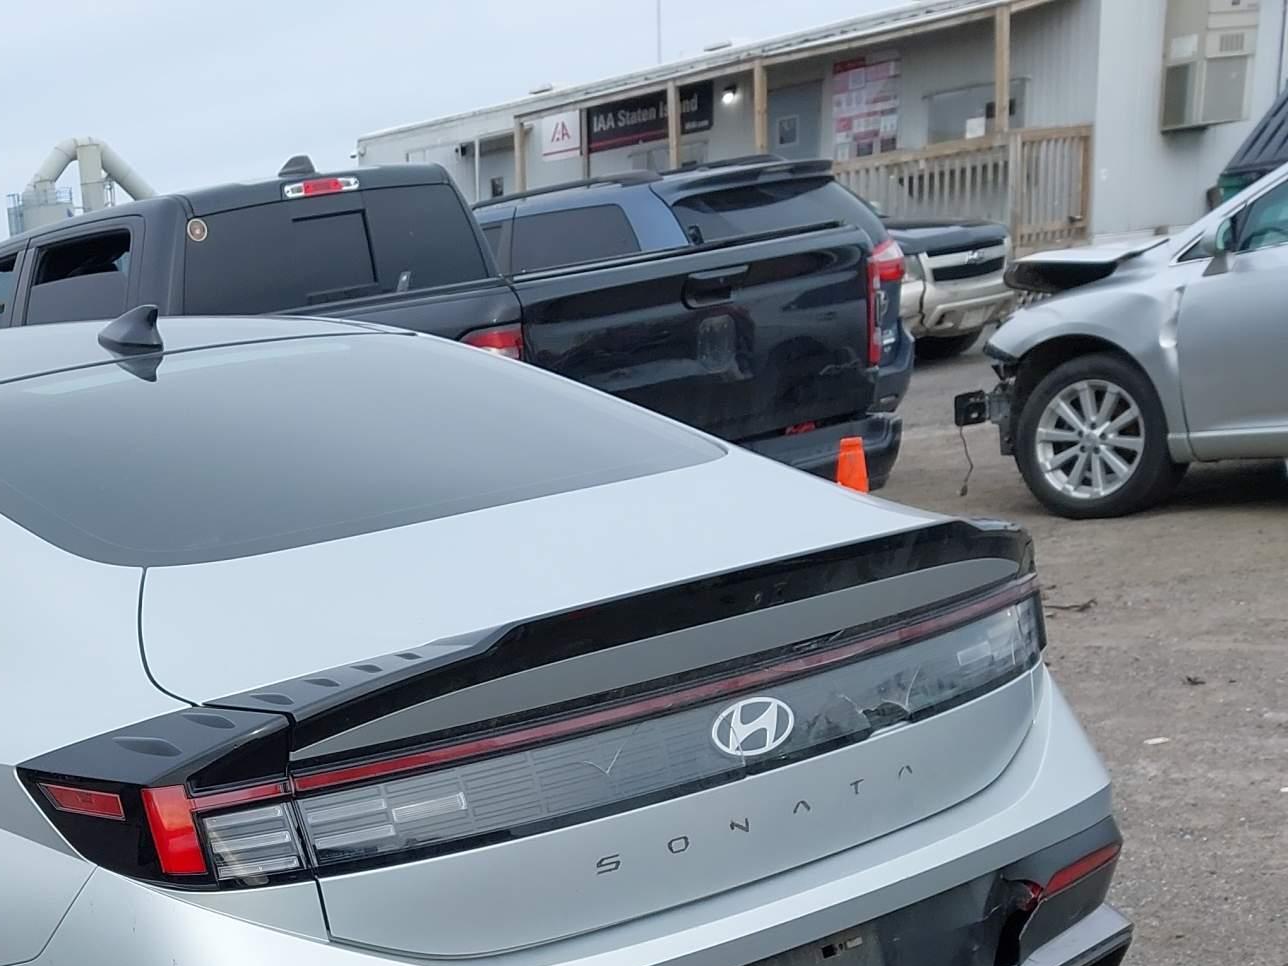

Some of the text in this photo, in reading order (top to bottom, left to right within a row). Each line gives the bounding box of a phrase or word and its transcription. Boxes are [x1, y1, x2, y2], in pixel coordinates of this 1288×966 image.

[592, 111, 616, 133] IAA
[617, 104, 657, 127] Staten
[659, 93, 698, 118] Isnd
[596, 765, 913, 875] SONATA
